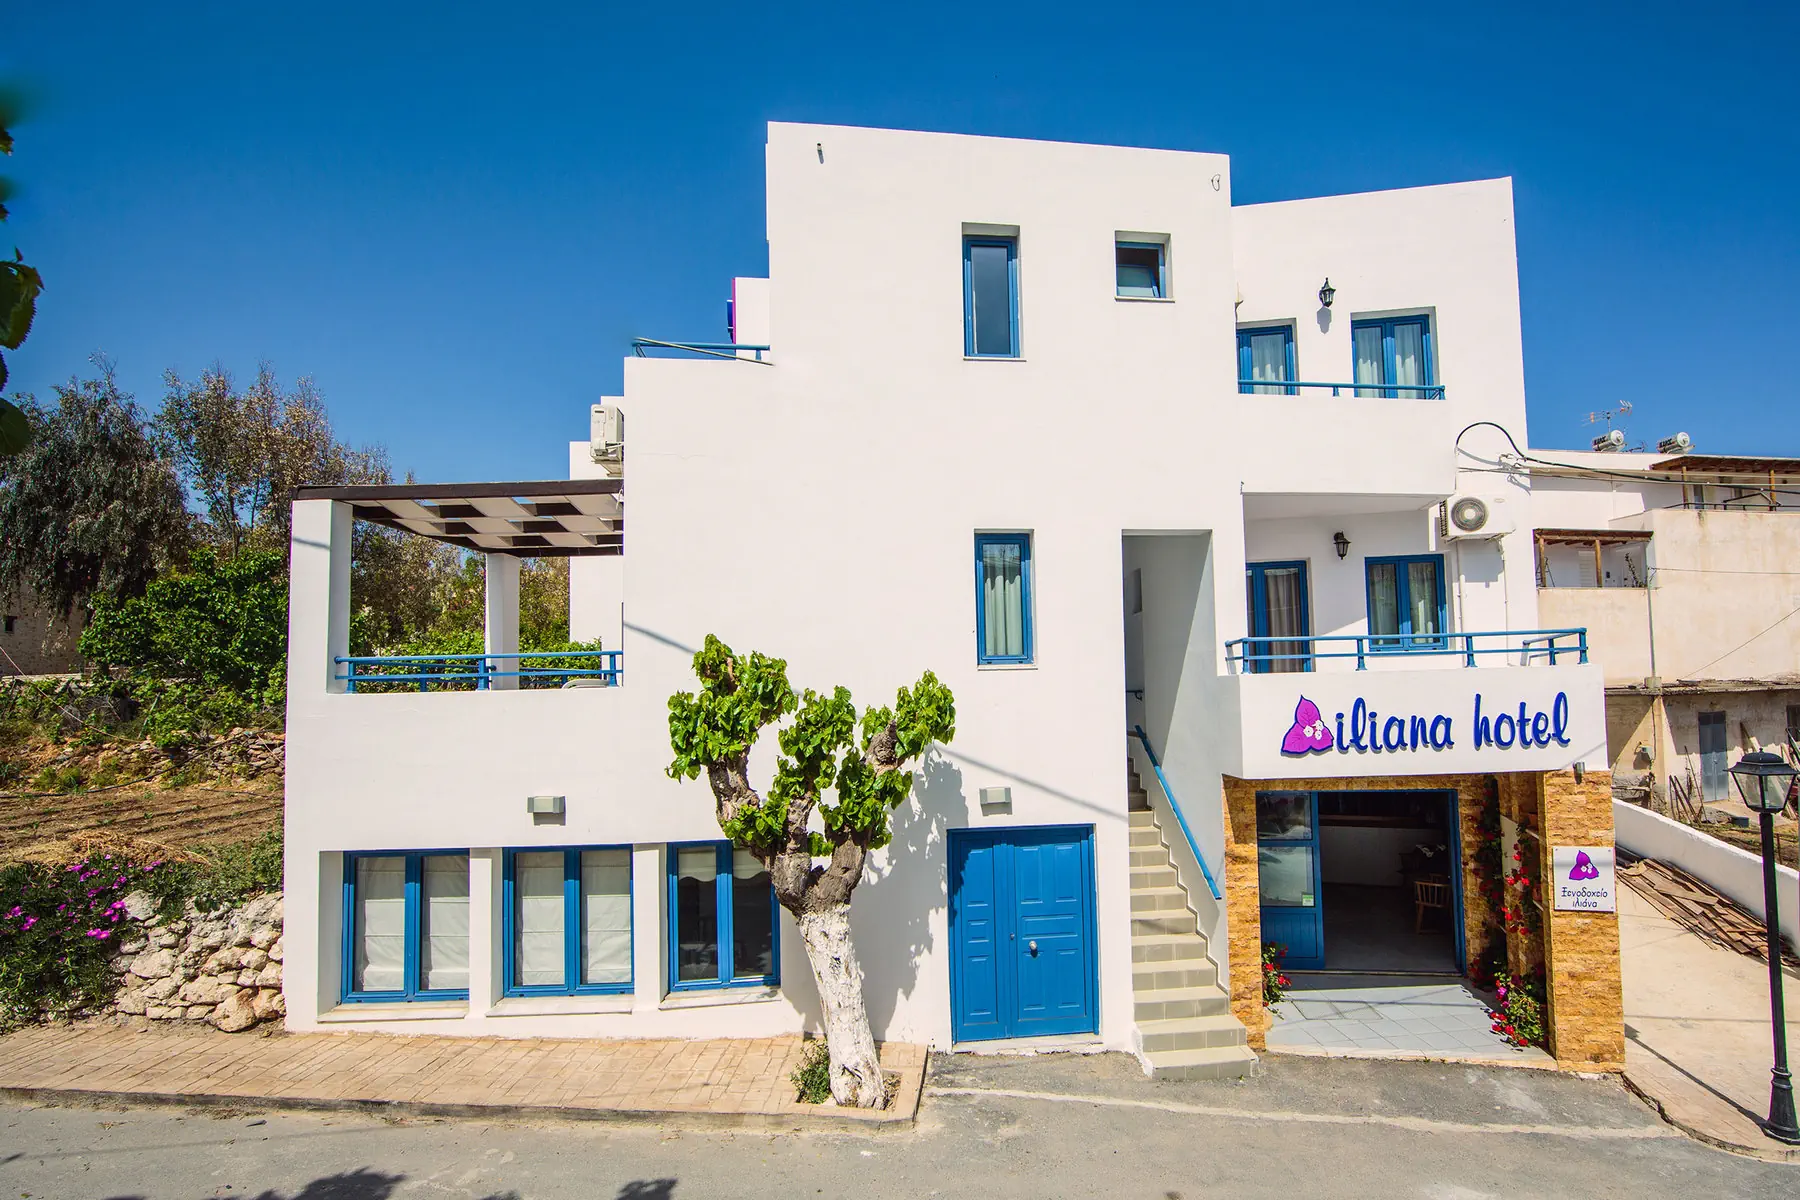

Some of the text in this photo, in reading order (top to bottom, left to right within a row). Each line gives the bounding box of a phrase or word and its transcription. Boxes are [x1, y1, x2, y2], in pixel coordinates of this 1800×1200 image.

[1335, 691, 1570, 752] iliana hotel
[1561, 886, 1608, 898] Ξενοδοχείο
